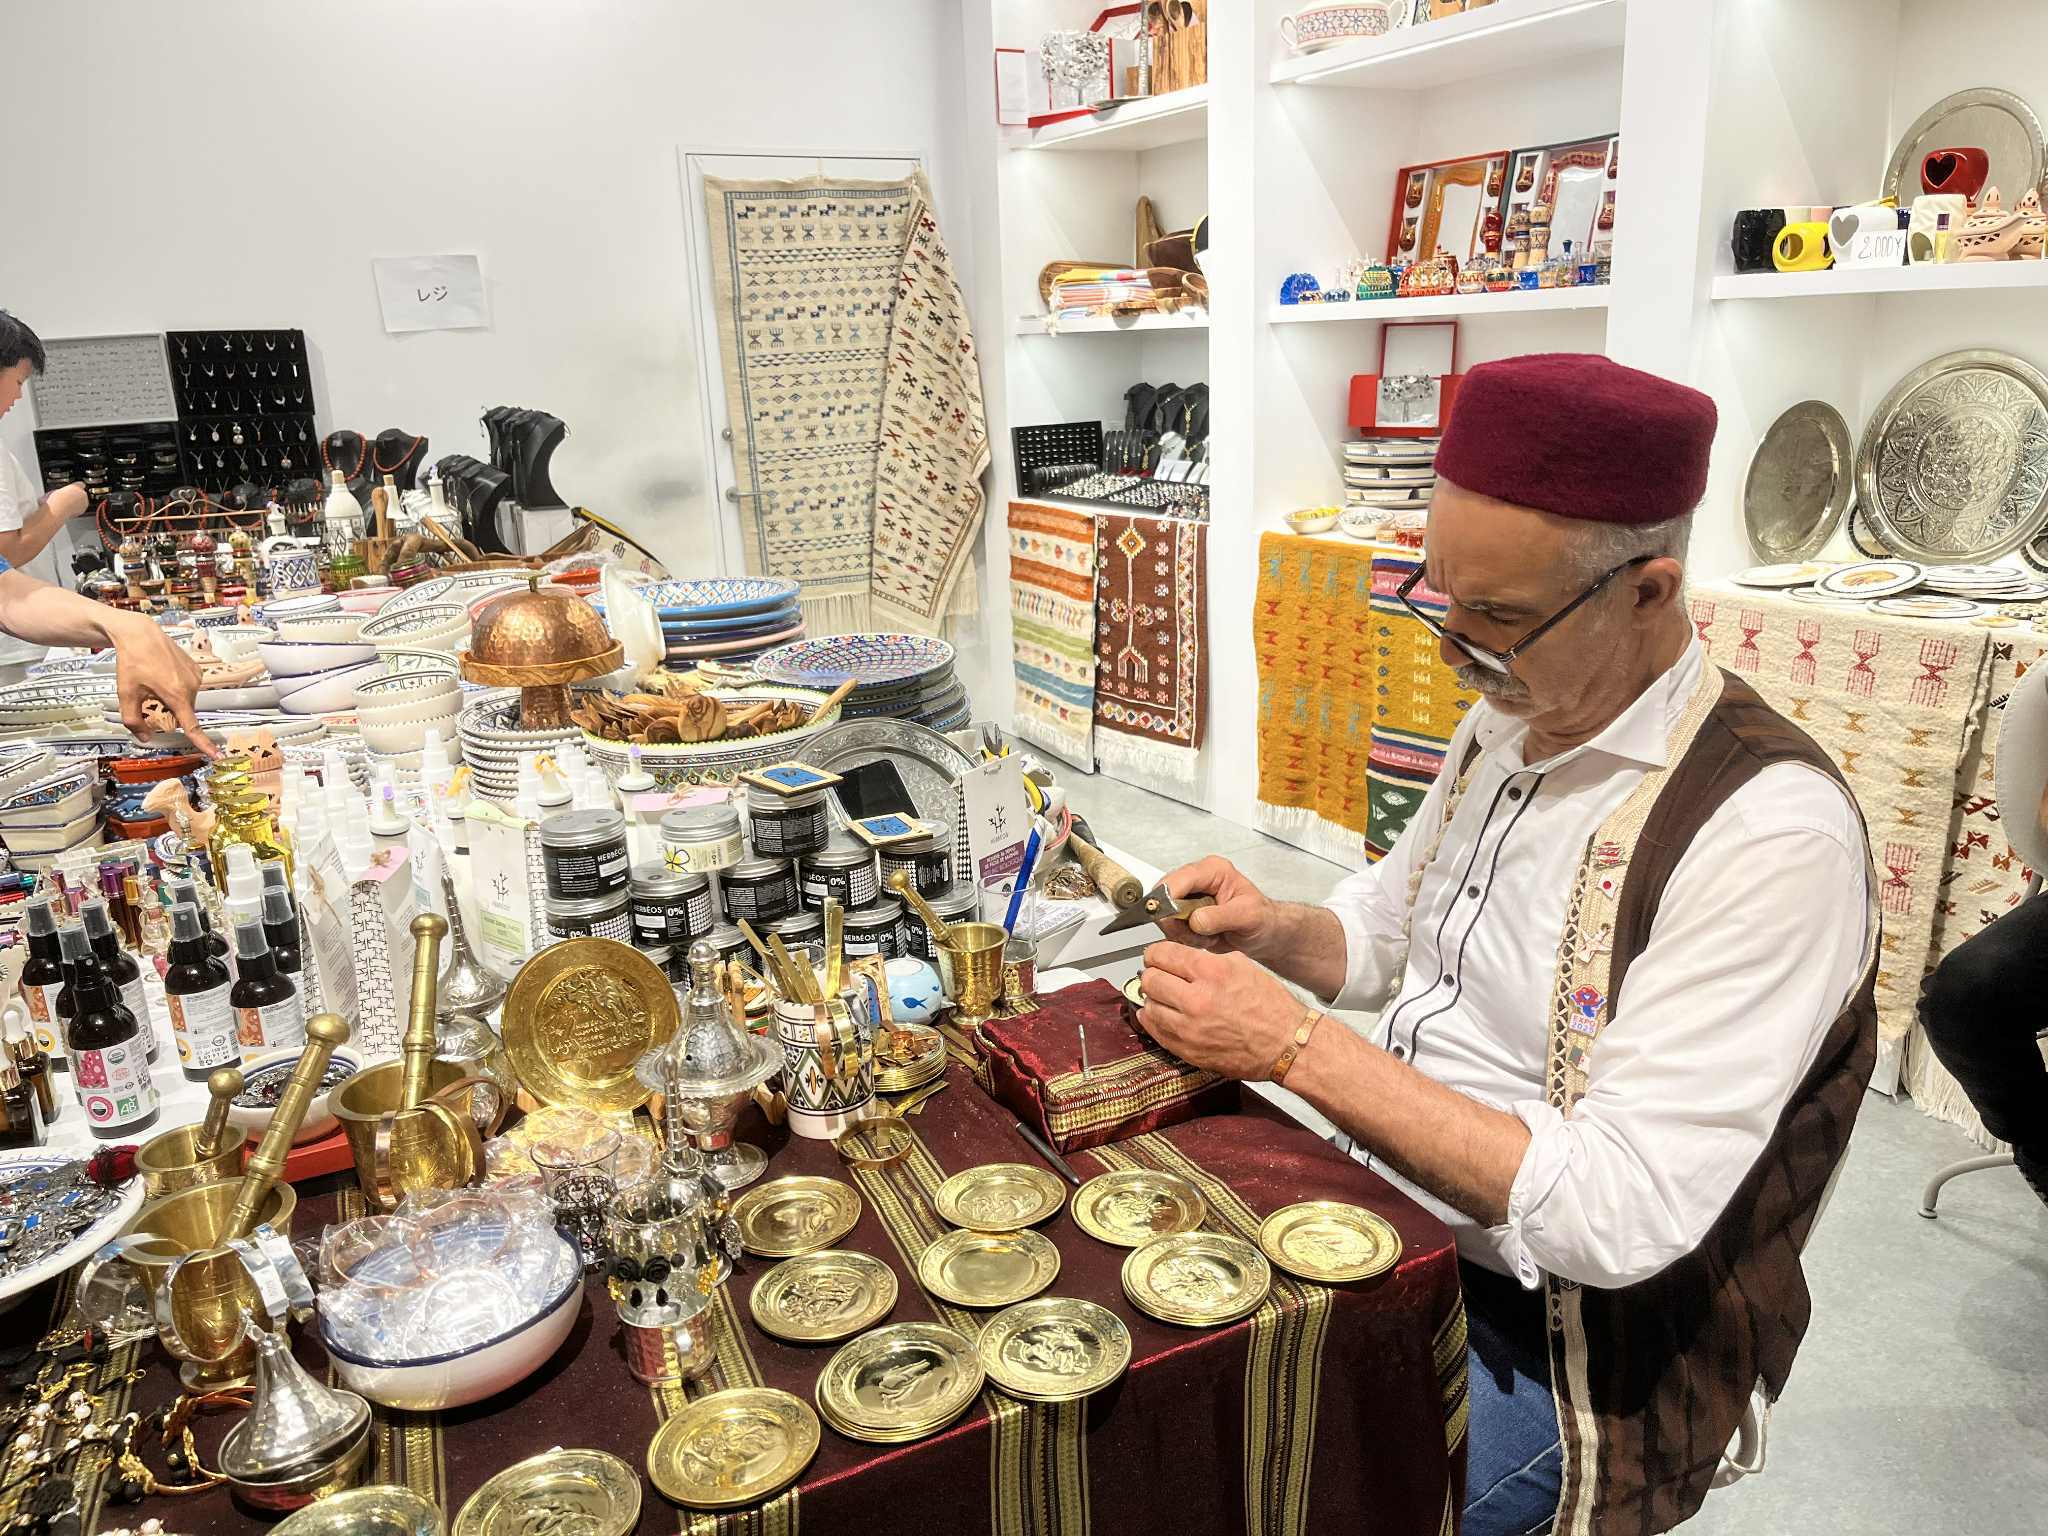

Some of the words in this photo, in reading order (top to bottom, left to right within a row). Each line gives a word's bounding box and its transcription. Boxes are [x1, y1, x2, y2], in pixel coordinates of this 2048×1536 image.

[416, 285, 448, 302] レジ
[830, 877, 846, 886] 0%
[667, 906, 684, 917] 0%
[911, 925, 923, 935] 0%
[880, 932, 893, 942] 0%
[1572, 1013, 1596, 1026] EXPO
